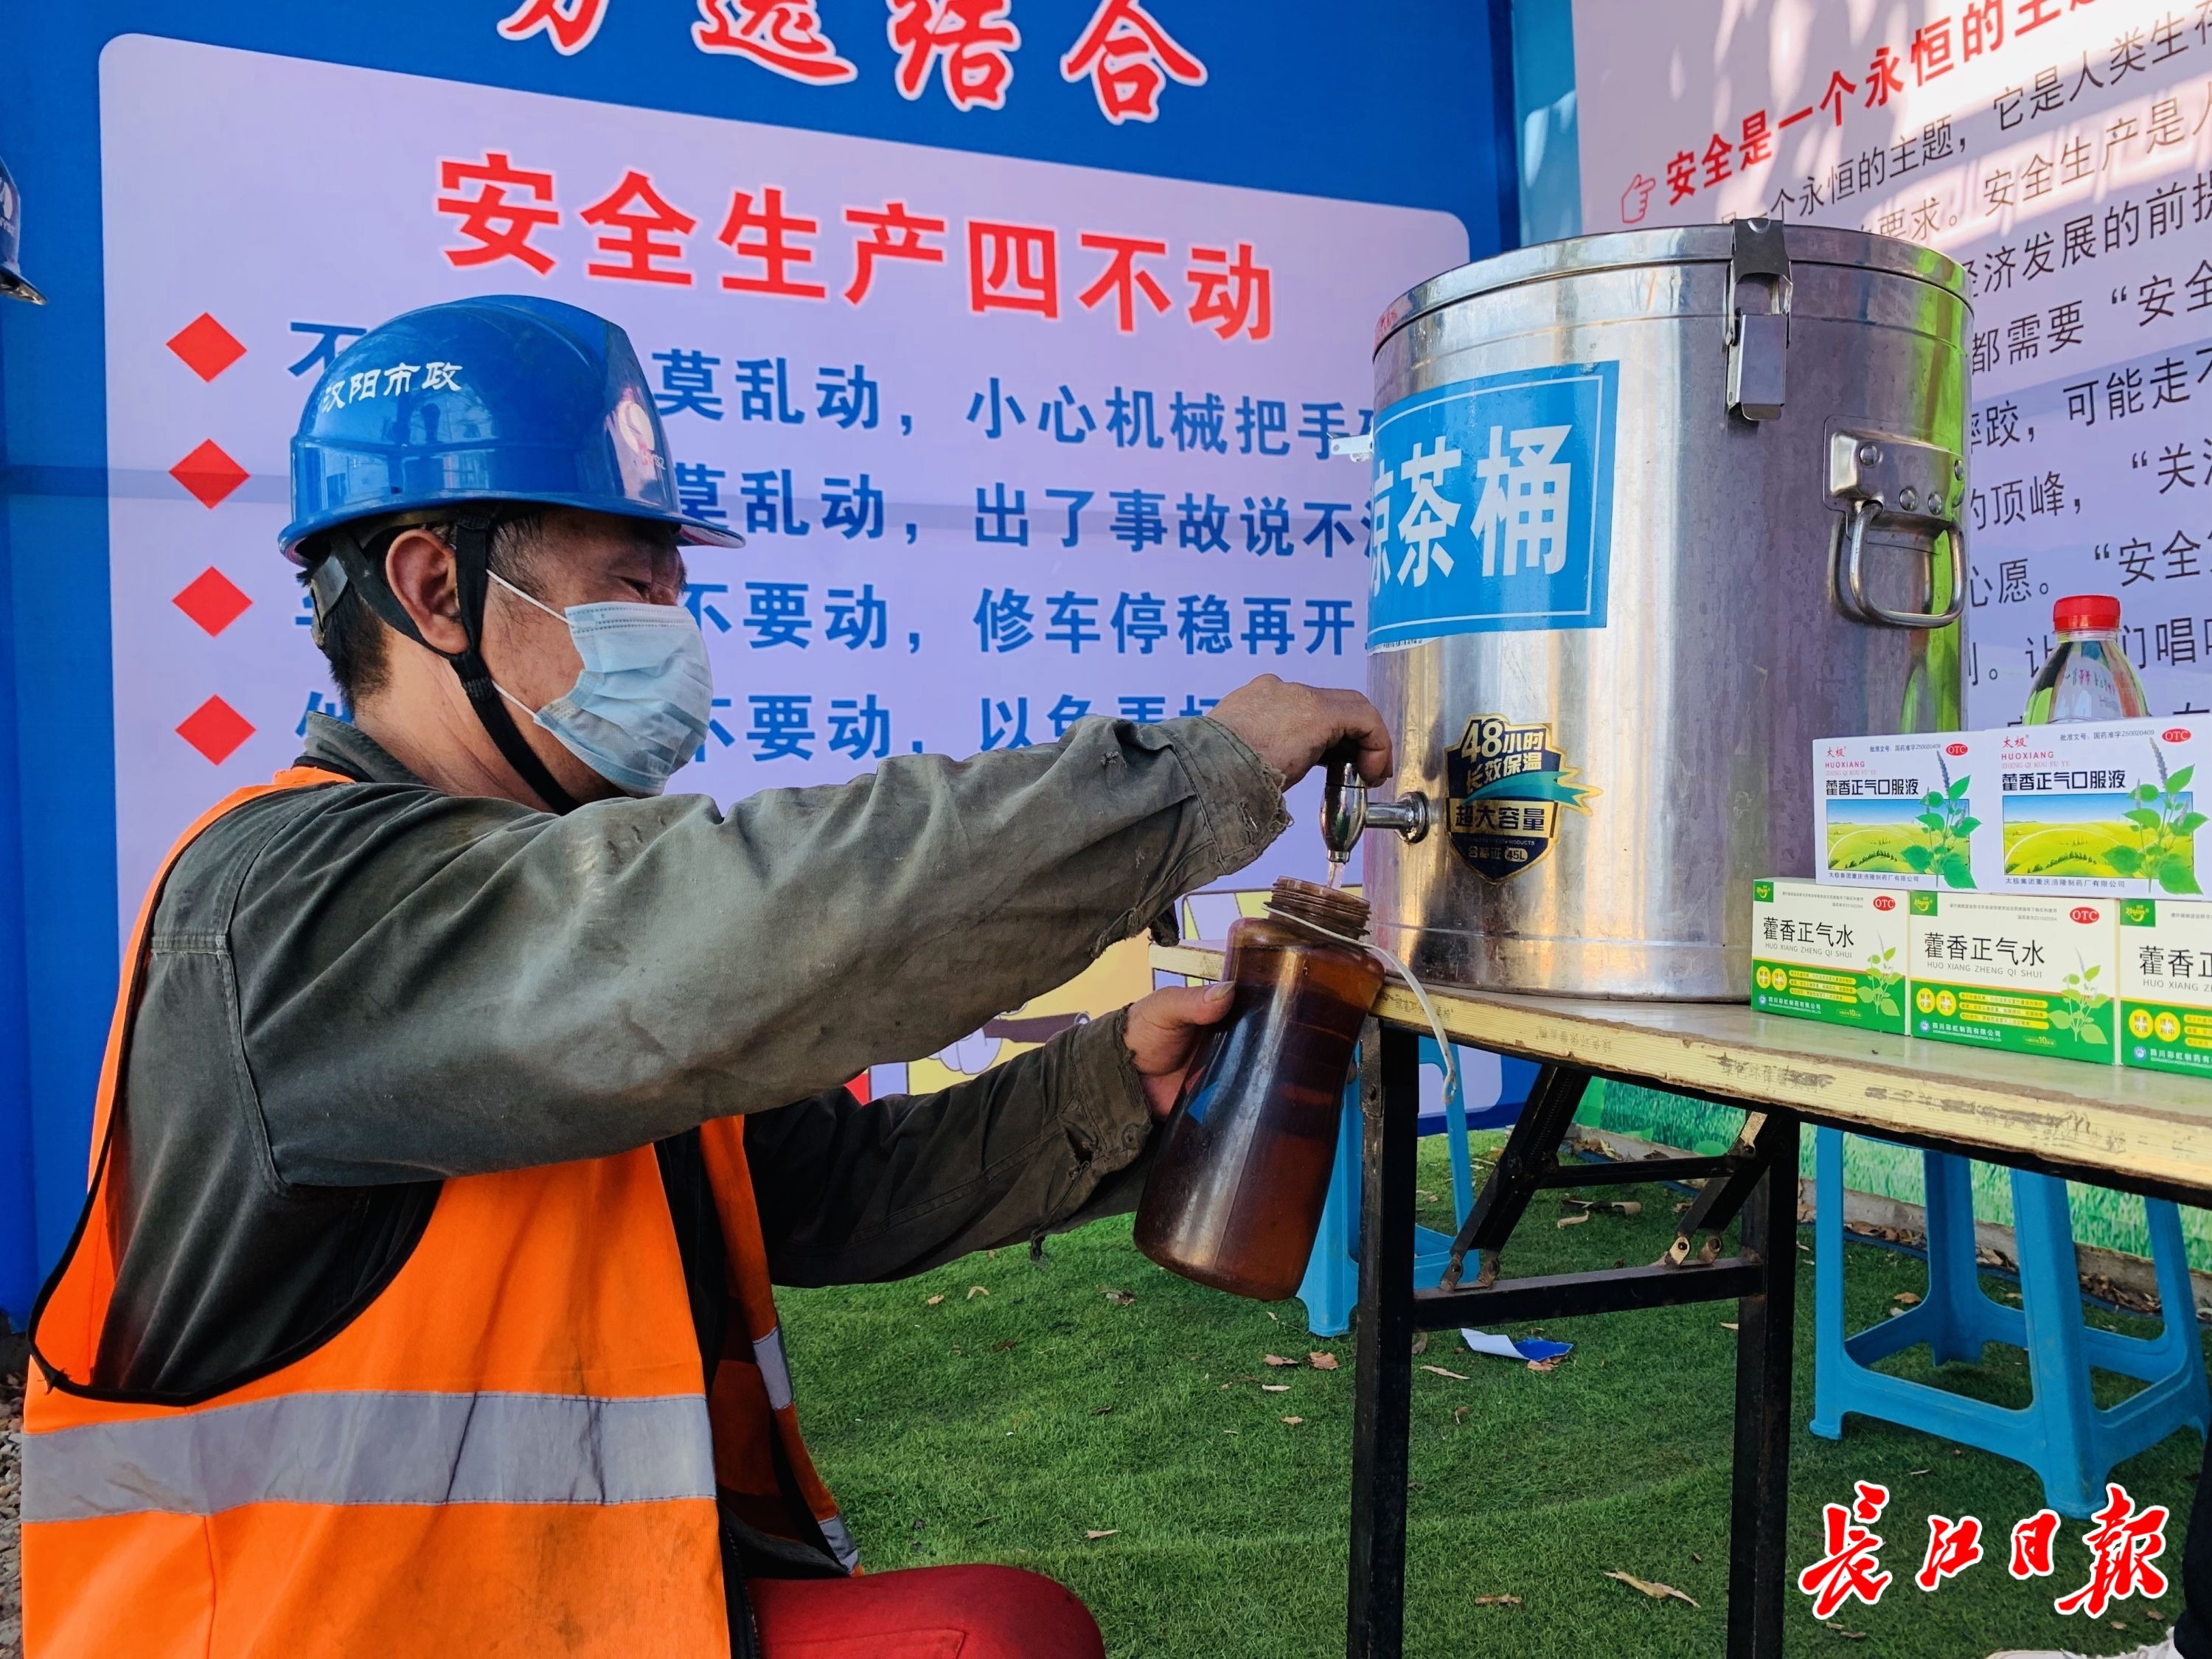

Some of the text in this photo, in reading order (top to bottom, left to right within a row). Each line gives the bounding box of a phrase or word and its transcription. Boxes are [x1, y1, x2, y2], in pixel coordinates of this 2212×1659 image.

[1666, 0, 2096, 206] 安全是一个永恒的主
[437, 153, 1272, 341] 安全生产四不动
[321, 362, 464, 414] 汉阳市政
[1461, 719, 1545, 762] 48小时
[2002, 736, 2028, 748] 太极
[2164, 729, 2190, 741] OTC
[1826, 746, 1845, 758] 太极
[1947, 745, 1968, 755] OTC
[2001, 751, 2054, 760] HUOXIANG
[1467, 751, 1543, 793] 长效保温
[2002, 769, 2126, 791] 藿香正气口服液
[1826, 779, 1919, 796] 藿香正气口服液
[1455, 804, 1545, 832] 超大容量
[1507, 849, 1526, 860] 45L
[1874, 898, 1894, 908] OTC
[2072, 910, 2098, 921] OTC
[1763, 917, 1854, 948] 藿香正气水
[1765, 942, 1778, 950] HUO
[1780, 944, 1798, 953] XIANG
[1801, 946, 1823, 956] ZHENG
[1835, 950, 1853, 959] SHUI
[1924, 931, 2045, 966] 藿香正气水
[1927, 961, 2042, 978] HUO XIANG ZHENG QI SHUI
[2143, 978, 2165, 988] HUO
[2168, 981, 2199, 992] XIANG
[2150, 1048, 2212, 1064] 四川彩虹制药有
